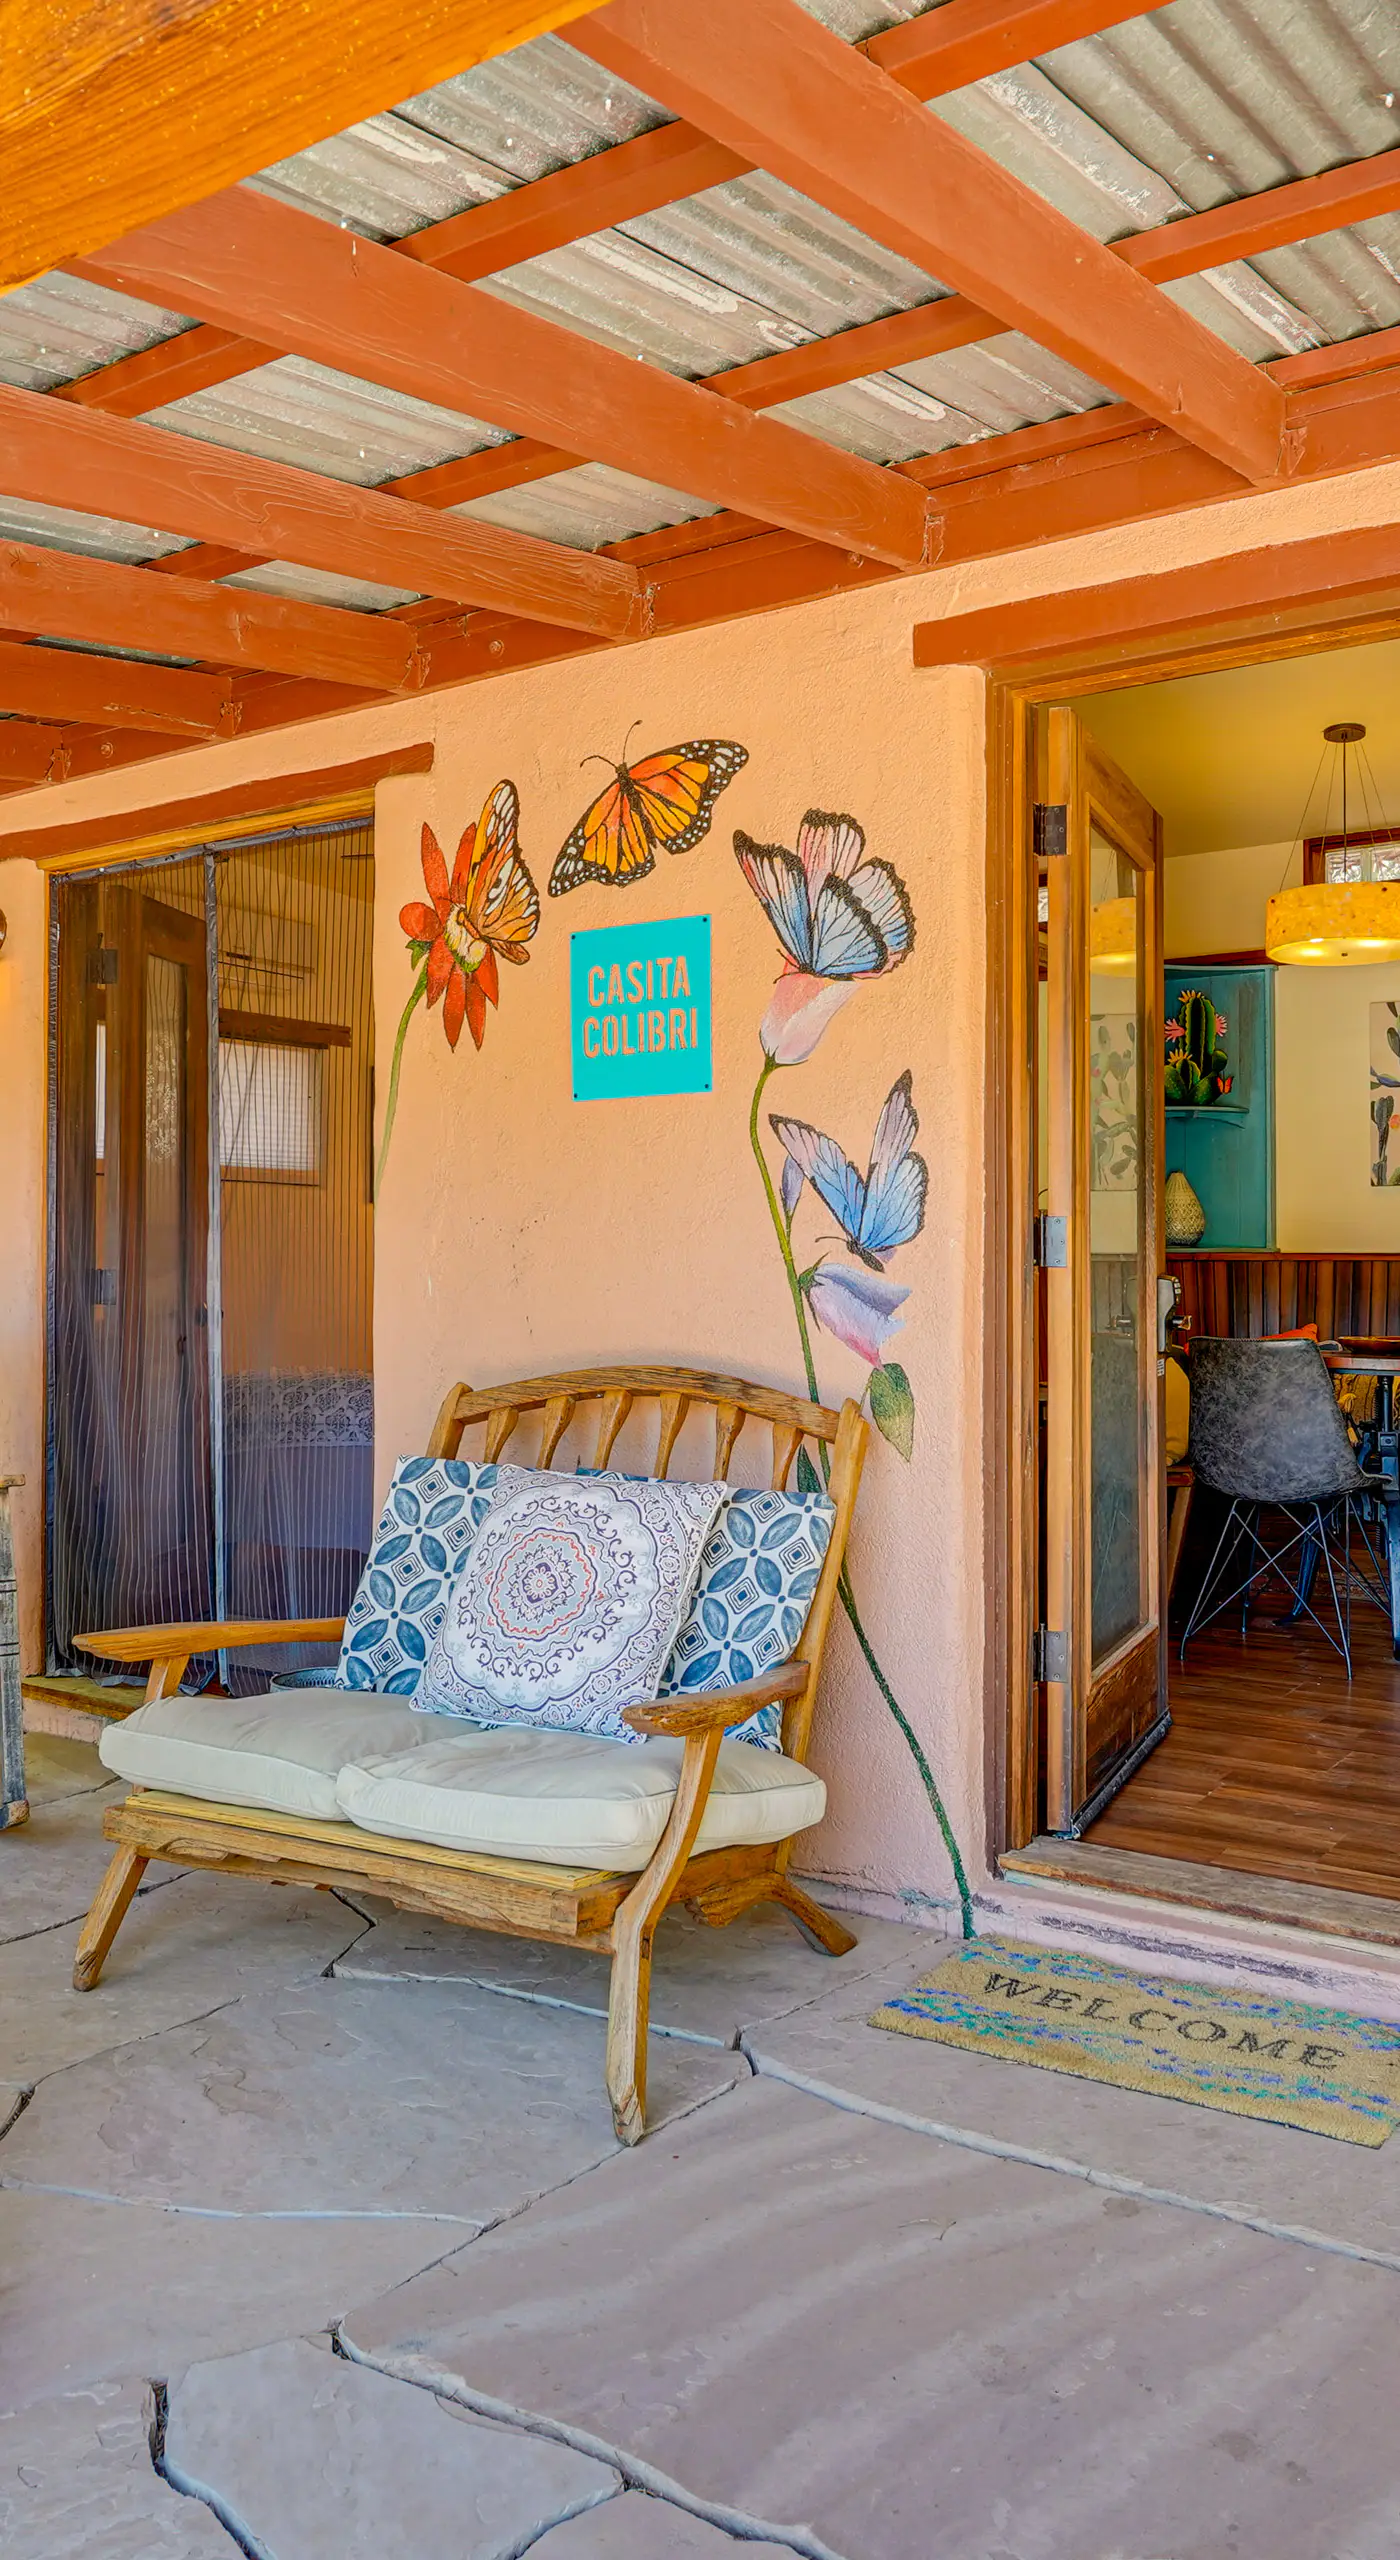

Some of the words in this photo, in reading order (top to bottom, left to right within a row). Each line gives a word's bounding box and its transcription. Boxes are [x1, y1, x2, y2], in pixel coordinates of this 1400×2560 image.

[588, 956, 691, 1007] CASITA
[583, 1007, 698, 1058] COLIBRI
[984, 1972, 1346, 2069] WELCOME
